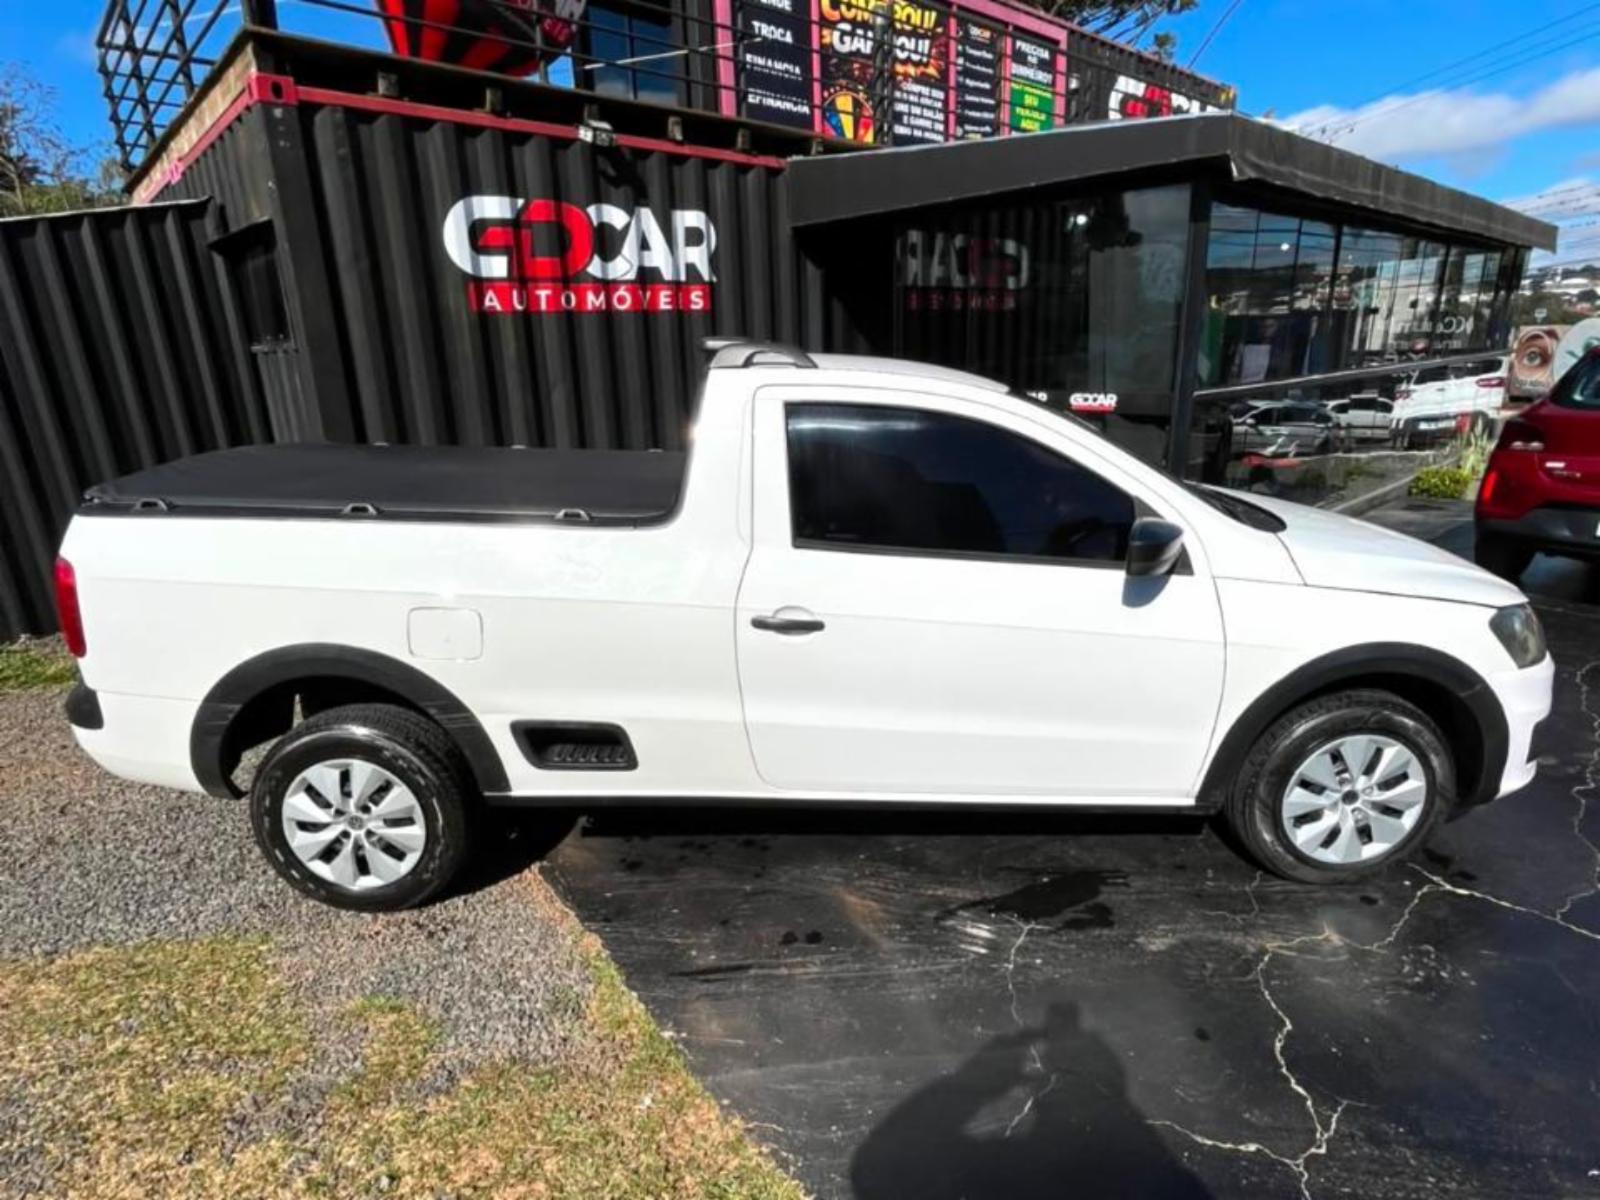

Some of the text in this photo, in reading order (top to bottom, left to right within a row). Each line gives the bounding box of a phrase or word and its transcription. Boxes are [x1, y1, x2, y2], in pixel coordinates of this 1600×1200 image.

[751, 20, 794, 45] TROCA
[819, 0, 938, 35] COMROU!
[832, 22, 931, 64] GAOU!
[1108, 74, 1221, 120] GDC
[442, 194, 718, 283] GDCAR
[482, 286, 706, 312] AUTOMÓVEIS
